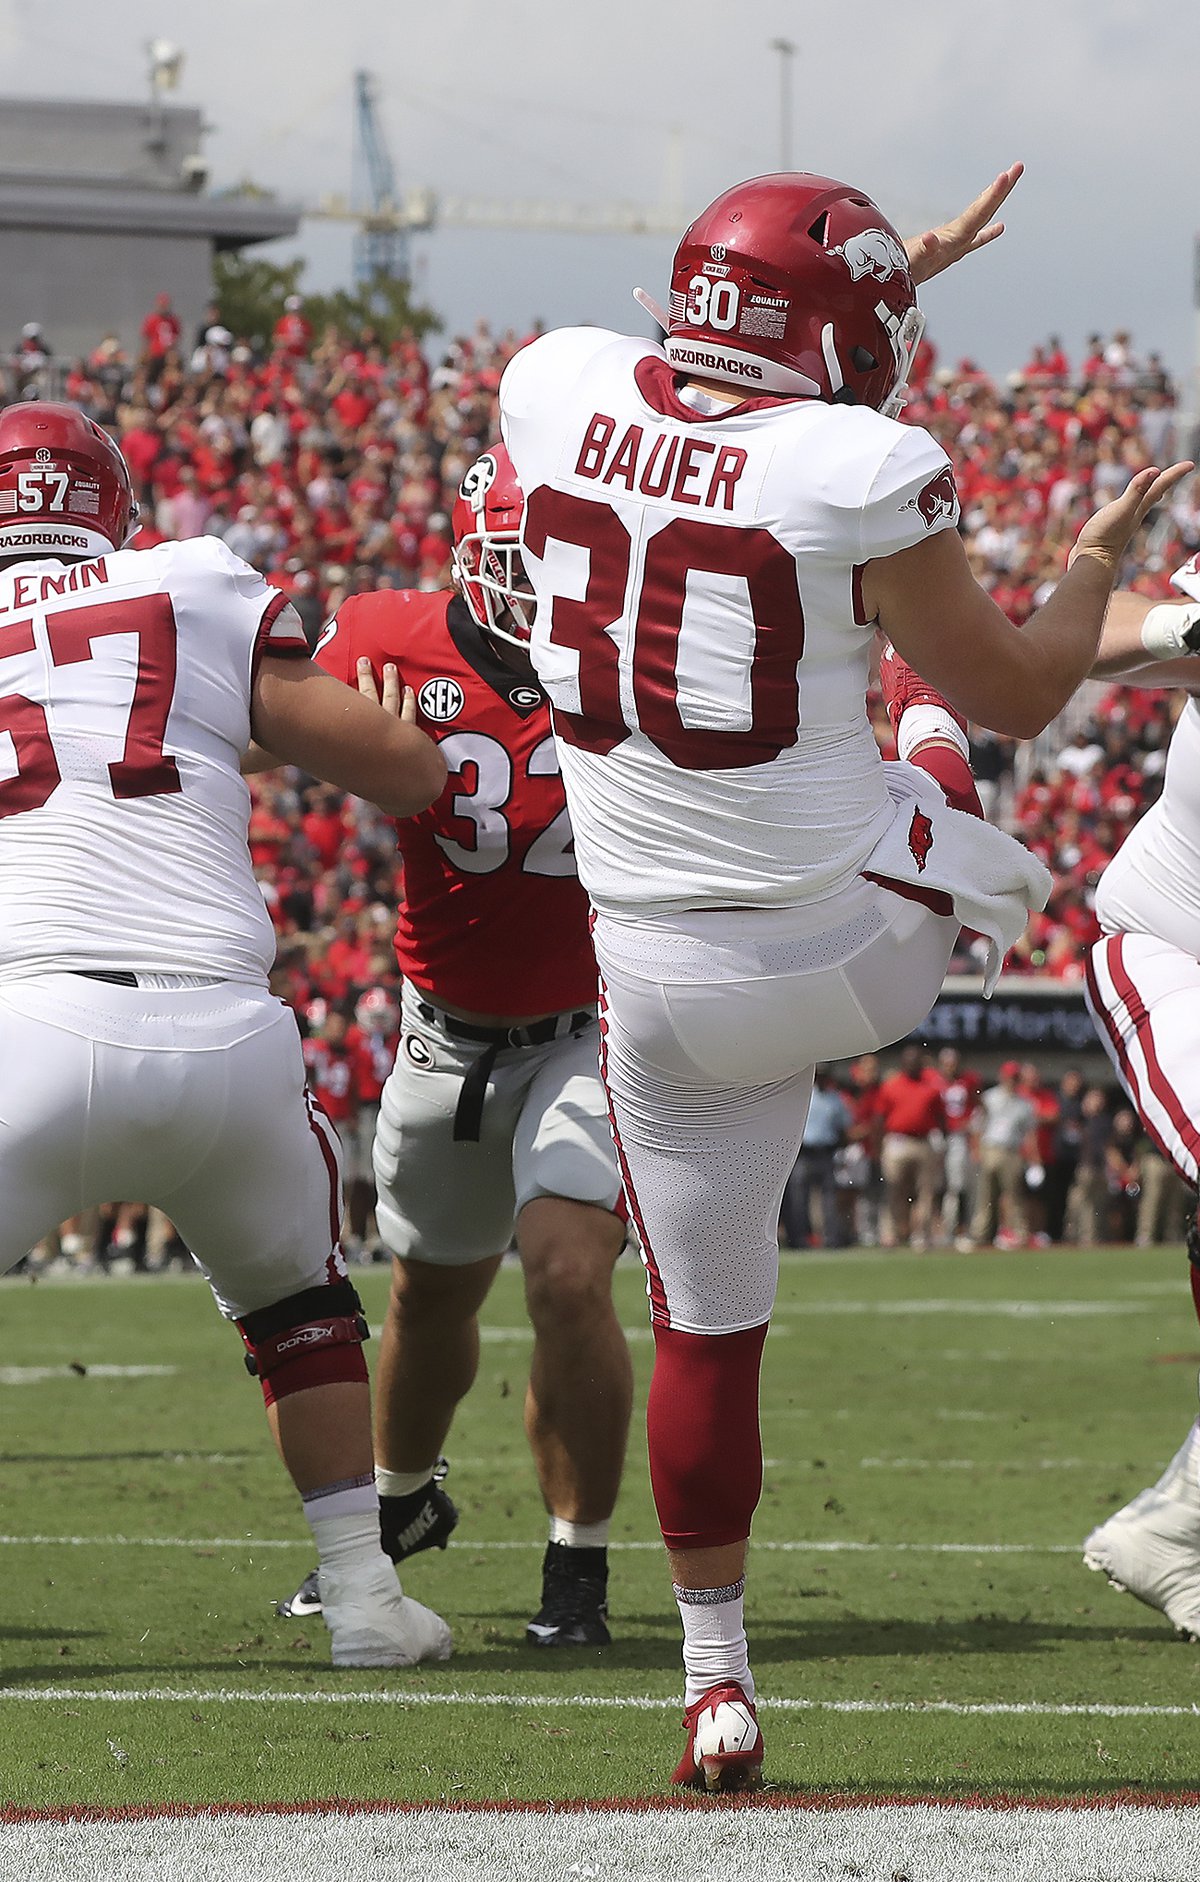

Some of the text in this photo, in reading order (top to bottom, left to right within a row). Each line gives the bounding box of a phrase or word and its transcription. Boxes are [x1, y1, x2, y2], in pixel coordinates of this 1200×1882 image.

[686, 275, 740, 331] 30
[750, 294, 790, 308] EQUALITY
[669, 348, 763, 380] RAZORBACKS
[574, 413, 748, 511] BAUER
[18, 473, 70, 512] 57
[74, 480, 100, 489] EQUALITY
[523, 484, 804, 771] 30
[420, 678, 463, 720] SEC
[433, 731, 577, 877] 32
[277, 1325, 336, 1353] DONJOY
[398, 1501, 438, 1551] NIKE
